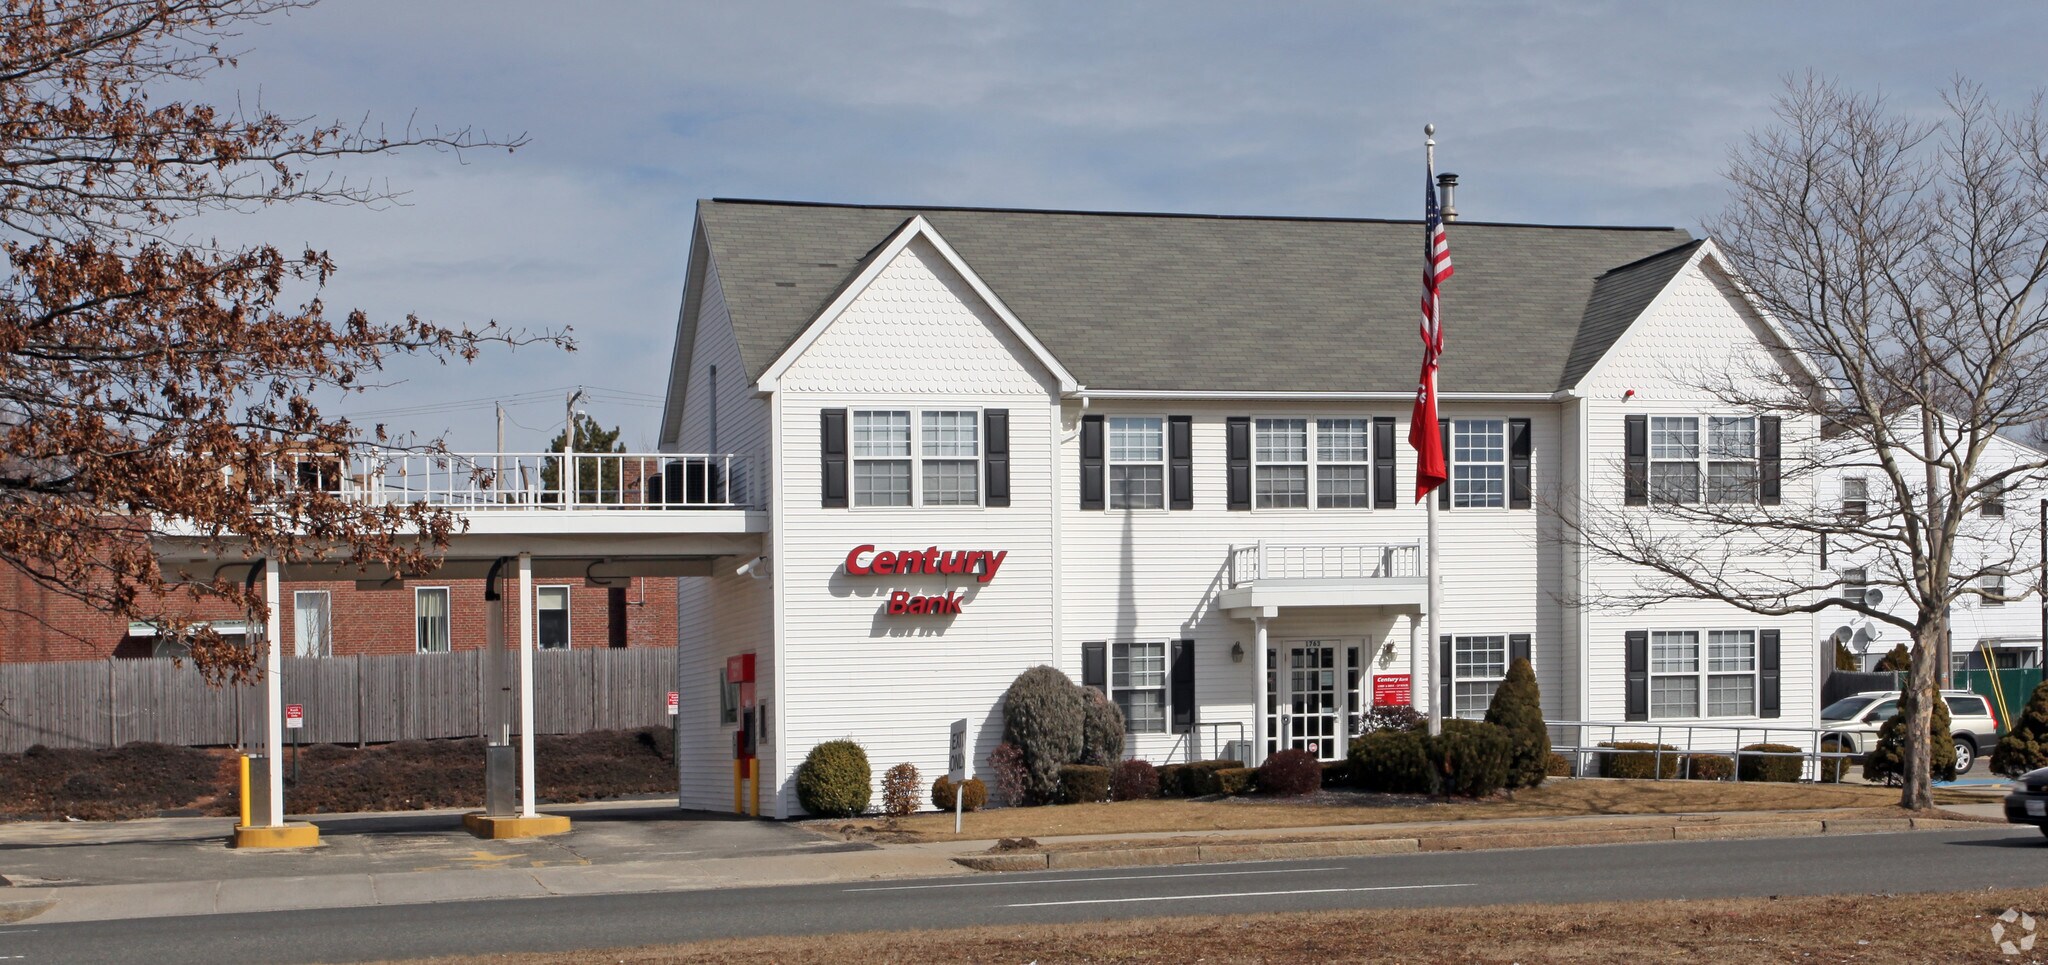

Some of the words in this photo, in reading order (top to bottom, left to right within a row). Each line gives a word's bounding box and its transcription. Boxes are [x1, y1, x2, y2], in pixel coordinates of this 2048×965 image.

[845, 544, 1008, 583] Century
[887, 591, 965, 615] Bank
[952, 731, 965, 751] EXIT
[950, 752, 965, 772] ONLY
